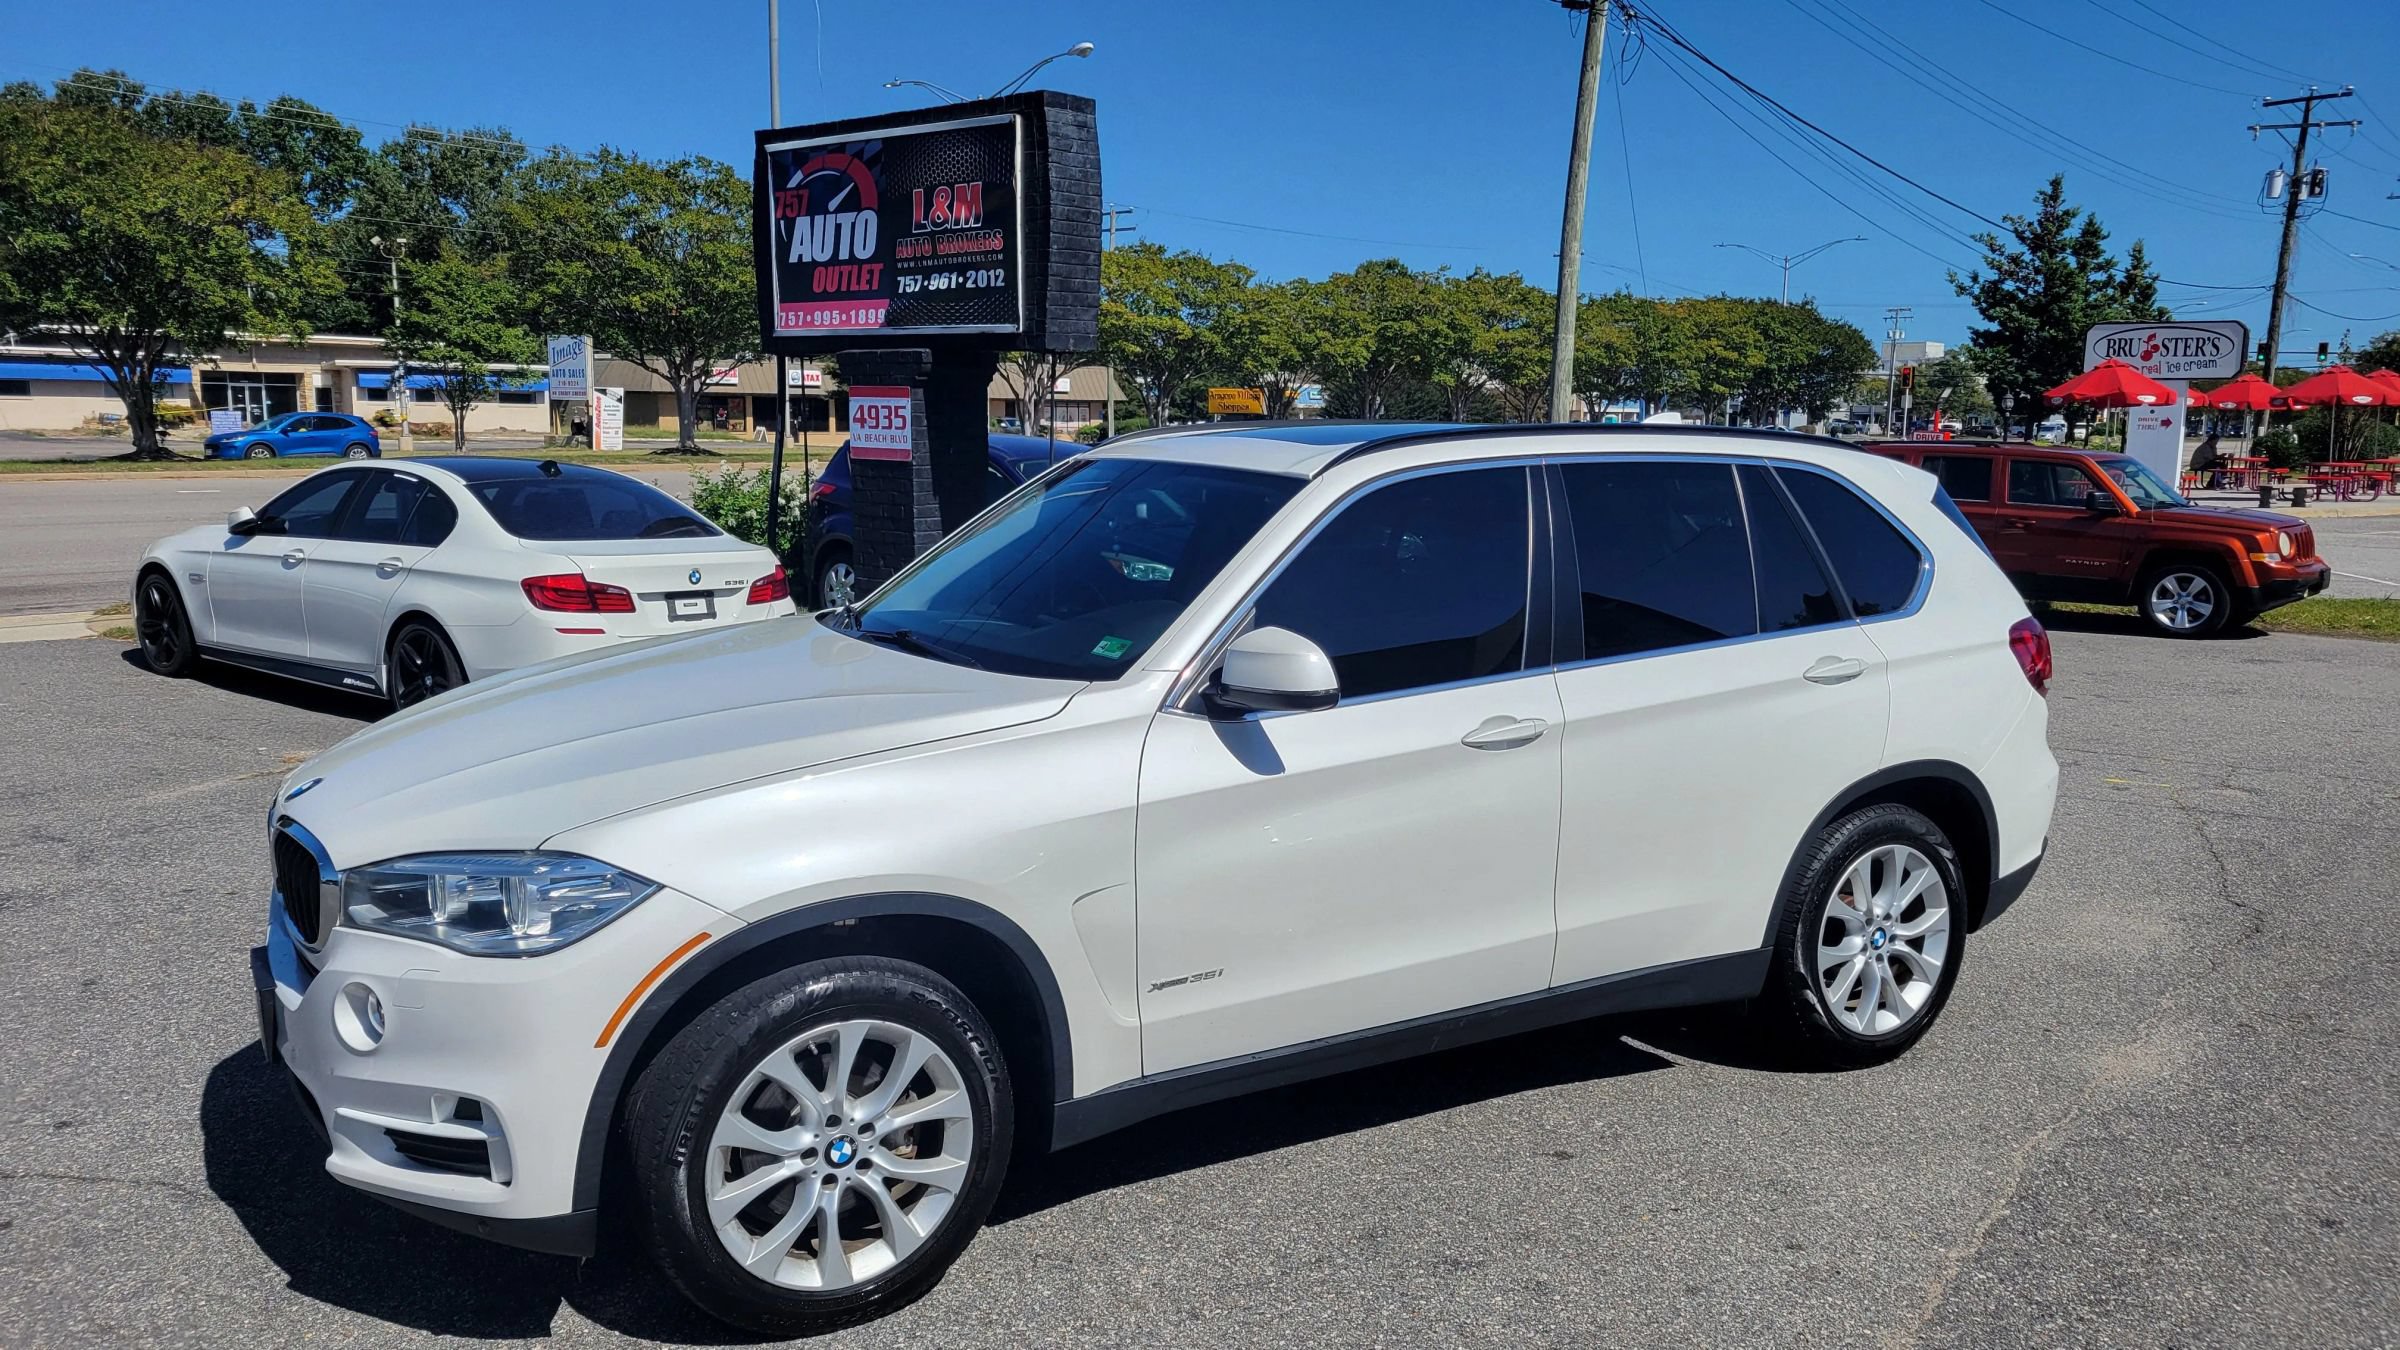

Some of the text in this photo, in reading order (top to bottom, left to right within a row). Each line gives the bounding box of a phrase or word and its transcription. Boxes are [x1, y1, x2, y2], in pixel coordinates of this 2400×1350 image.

[775, 189, 809, 218] 757
[912, 182, 983, 233] L&M
[788, 209, 878, 263] AUTO
[896, 229, 1004, 259] AUTO BROKERS
[812, 263, 883, 293] OUTLET
[552, 339, 584, 365] Image
[2105, 334, 2221, 360] BRUSTER'S
[552, 368, 585, 379] AUTO SALES
[804, 374, 821, 383] TAX
[2141, 358, 2218, 376] real ice cream
[853, 404, 907, 430] 4935
[864, 433, 887, 443] BEACH
[889, 434, 908, 444] BLVD
